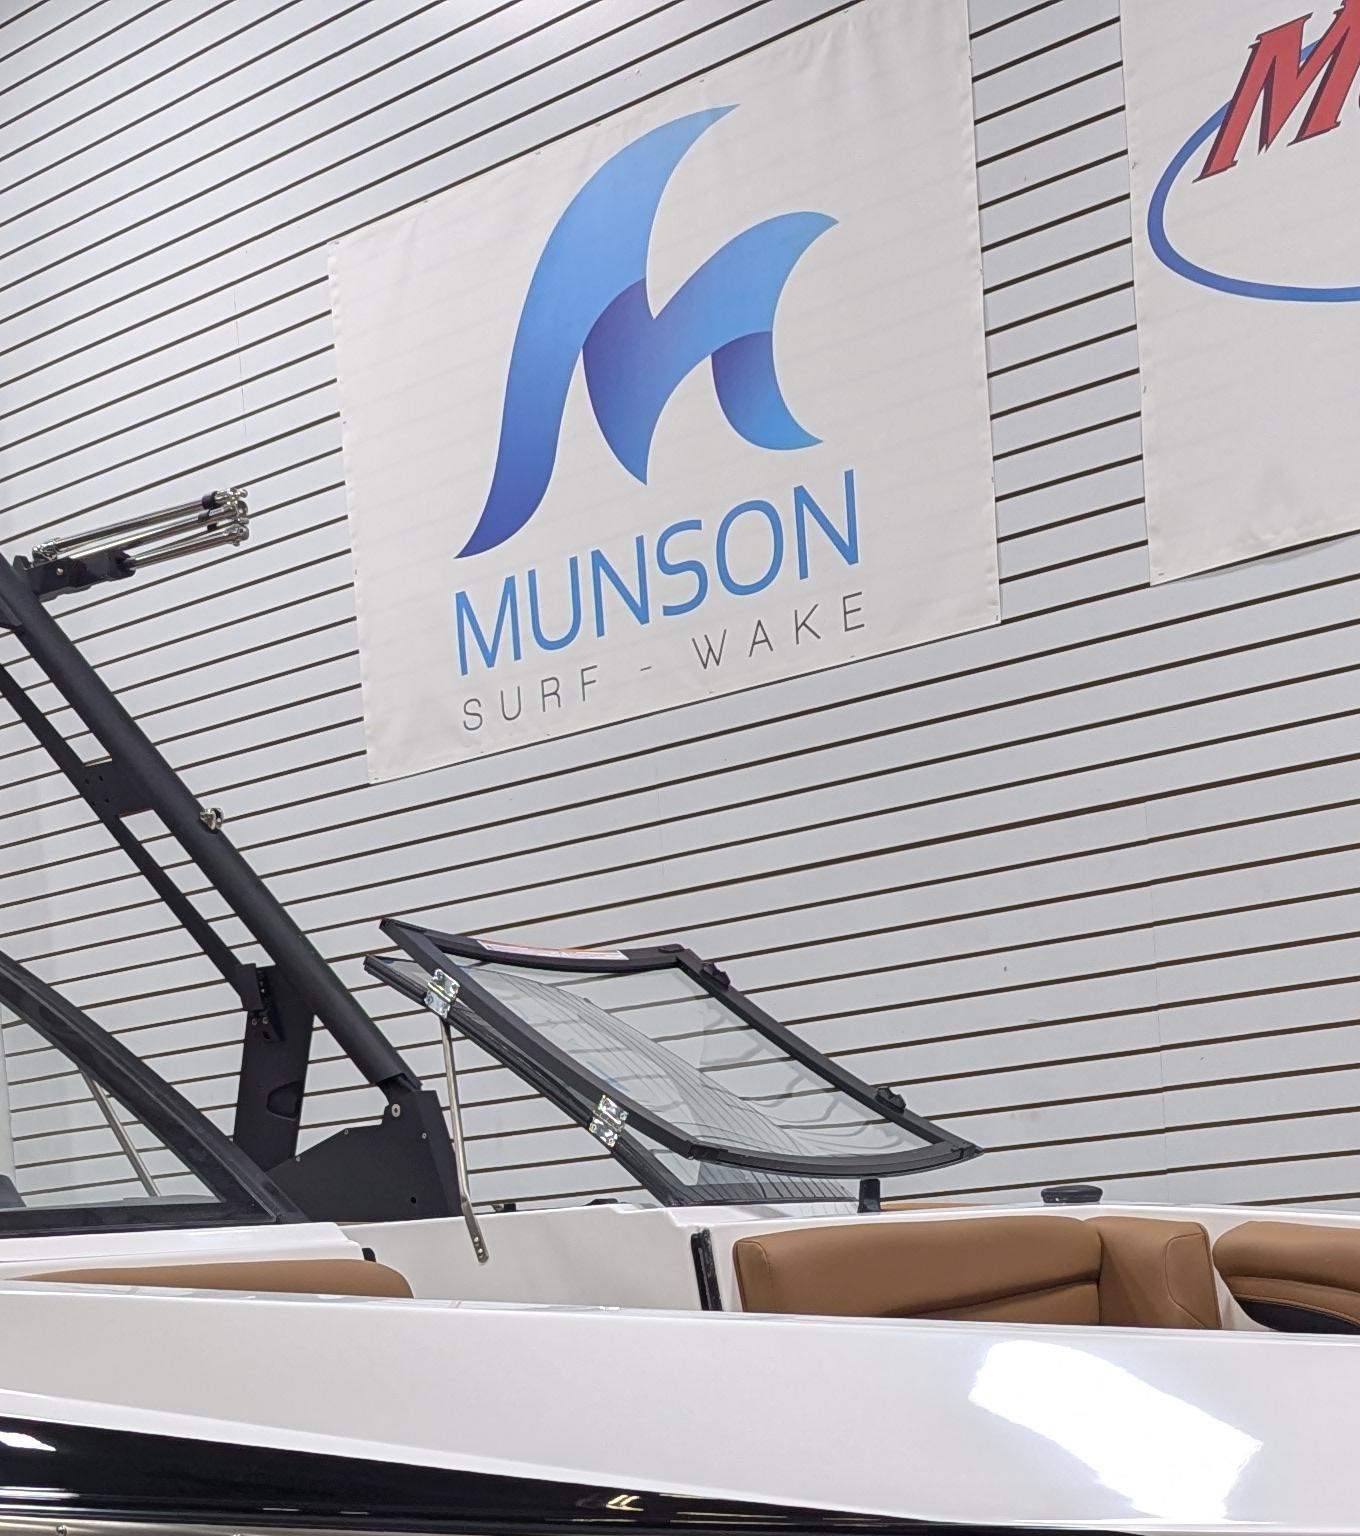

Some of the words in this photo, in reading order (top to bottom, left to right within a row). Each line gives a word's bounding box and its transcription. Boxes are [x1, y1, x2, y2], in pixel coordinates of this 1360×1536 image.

[454, 469, 860, 676] MUNSON
[462, 665, 599, 732] SURF
[692, 591, 865, 670] WAKE
